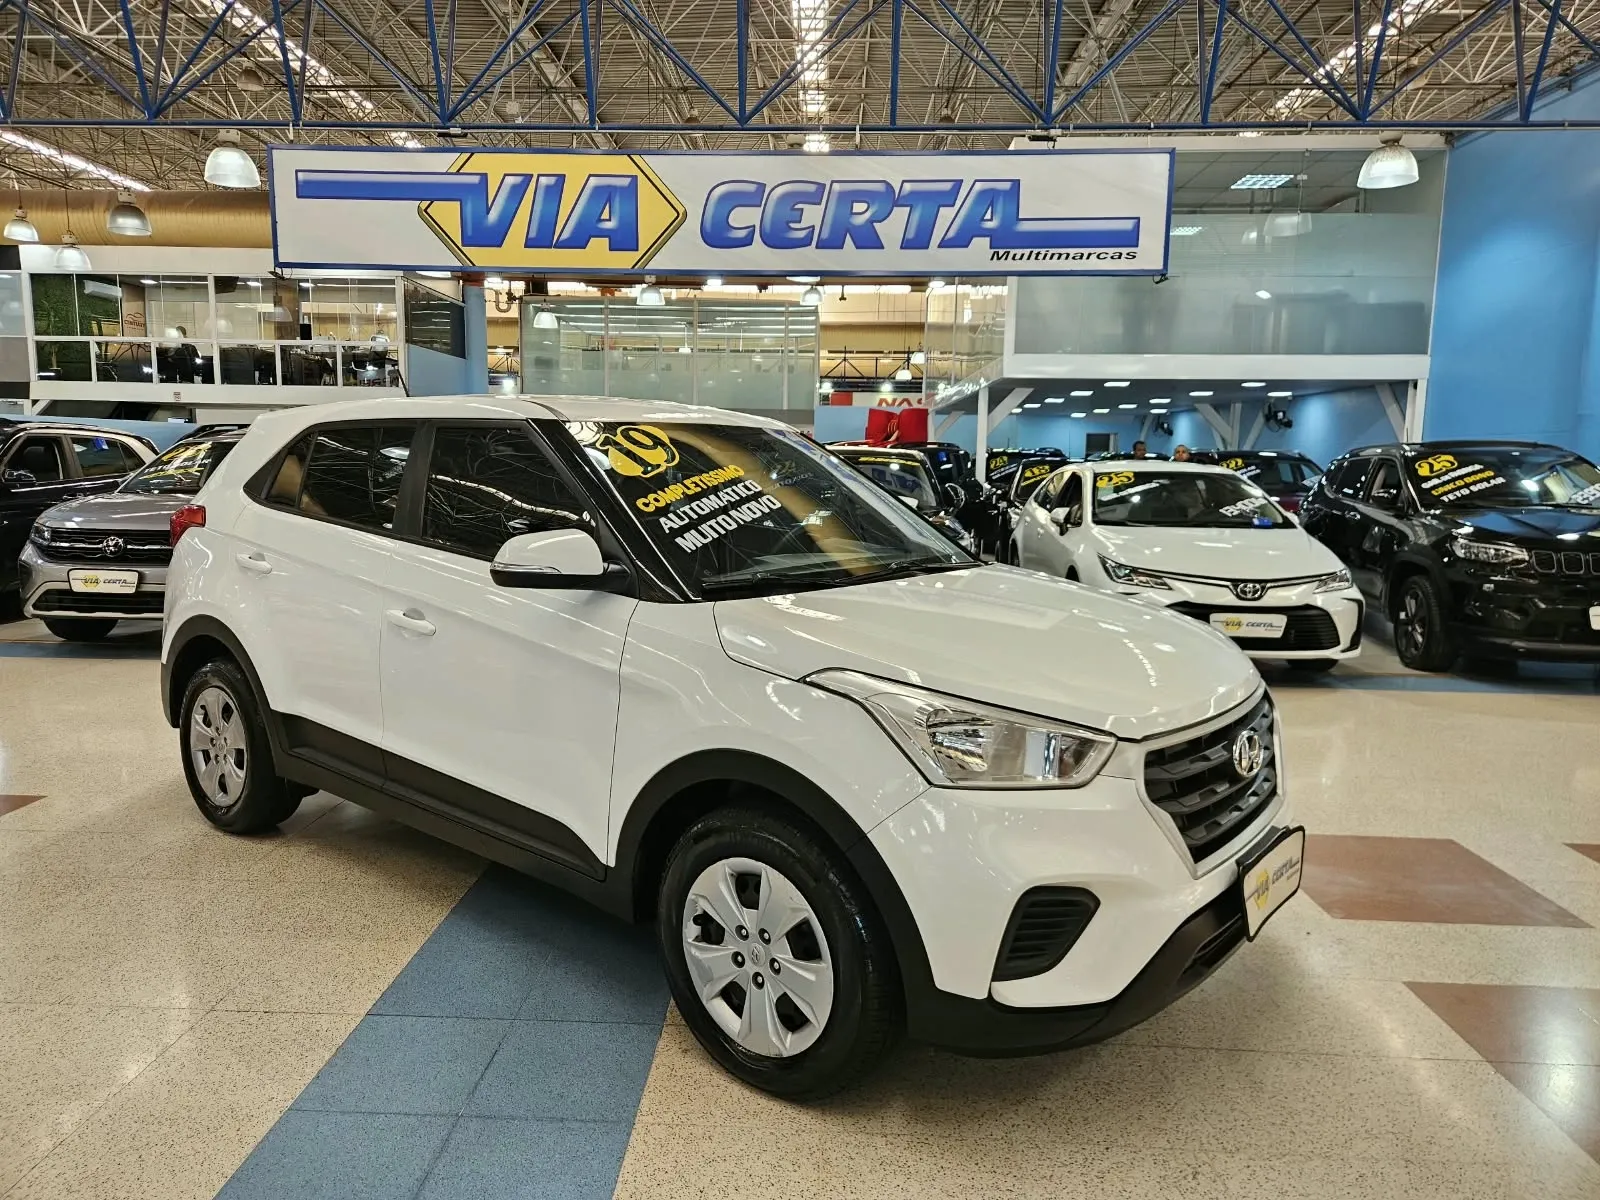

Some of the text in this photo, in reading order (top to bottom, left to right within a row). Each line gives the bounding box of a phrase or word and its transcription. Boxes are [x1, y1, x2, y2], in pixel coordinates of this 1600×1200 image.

[456, 172, 1026, 251] VIA CERTA
[989, 249, 1138, 262] Multimarcas
[595, 424, 680, 478] 19
[1414, 454, 1458, 476] 25
[635, 464, 745, 513] COMPLETISSIMO
[1095, 471, 1136, 488] 25
[658, 479, 763, 534] AUTOMATICO
[674, 494, 782, 553] MUITO NOVO
